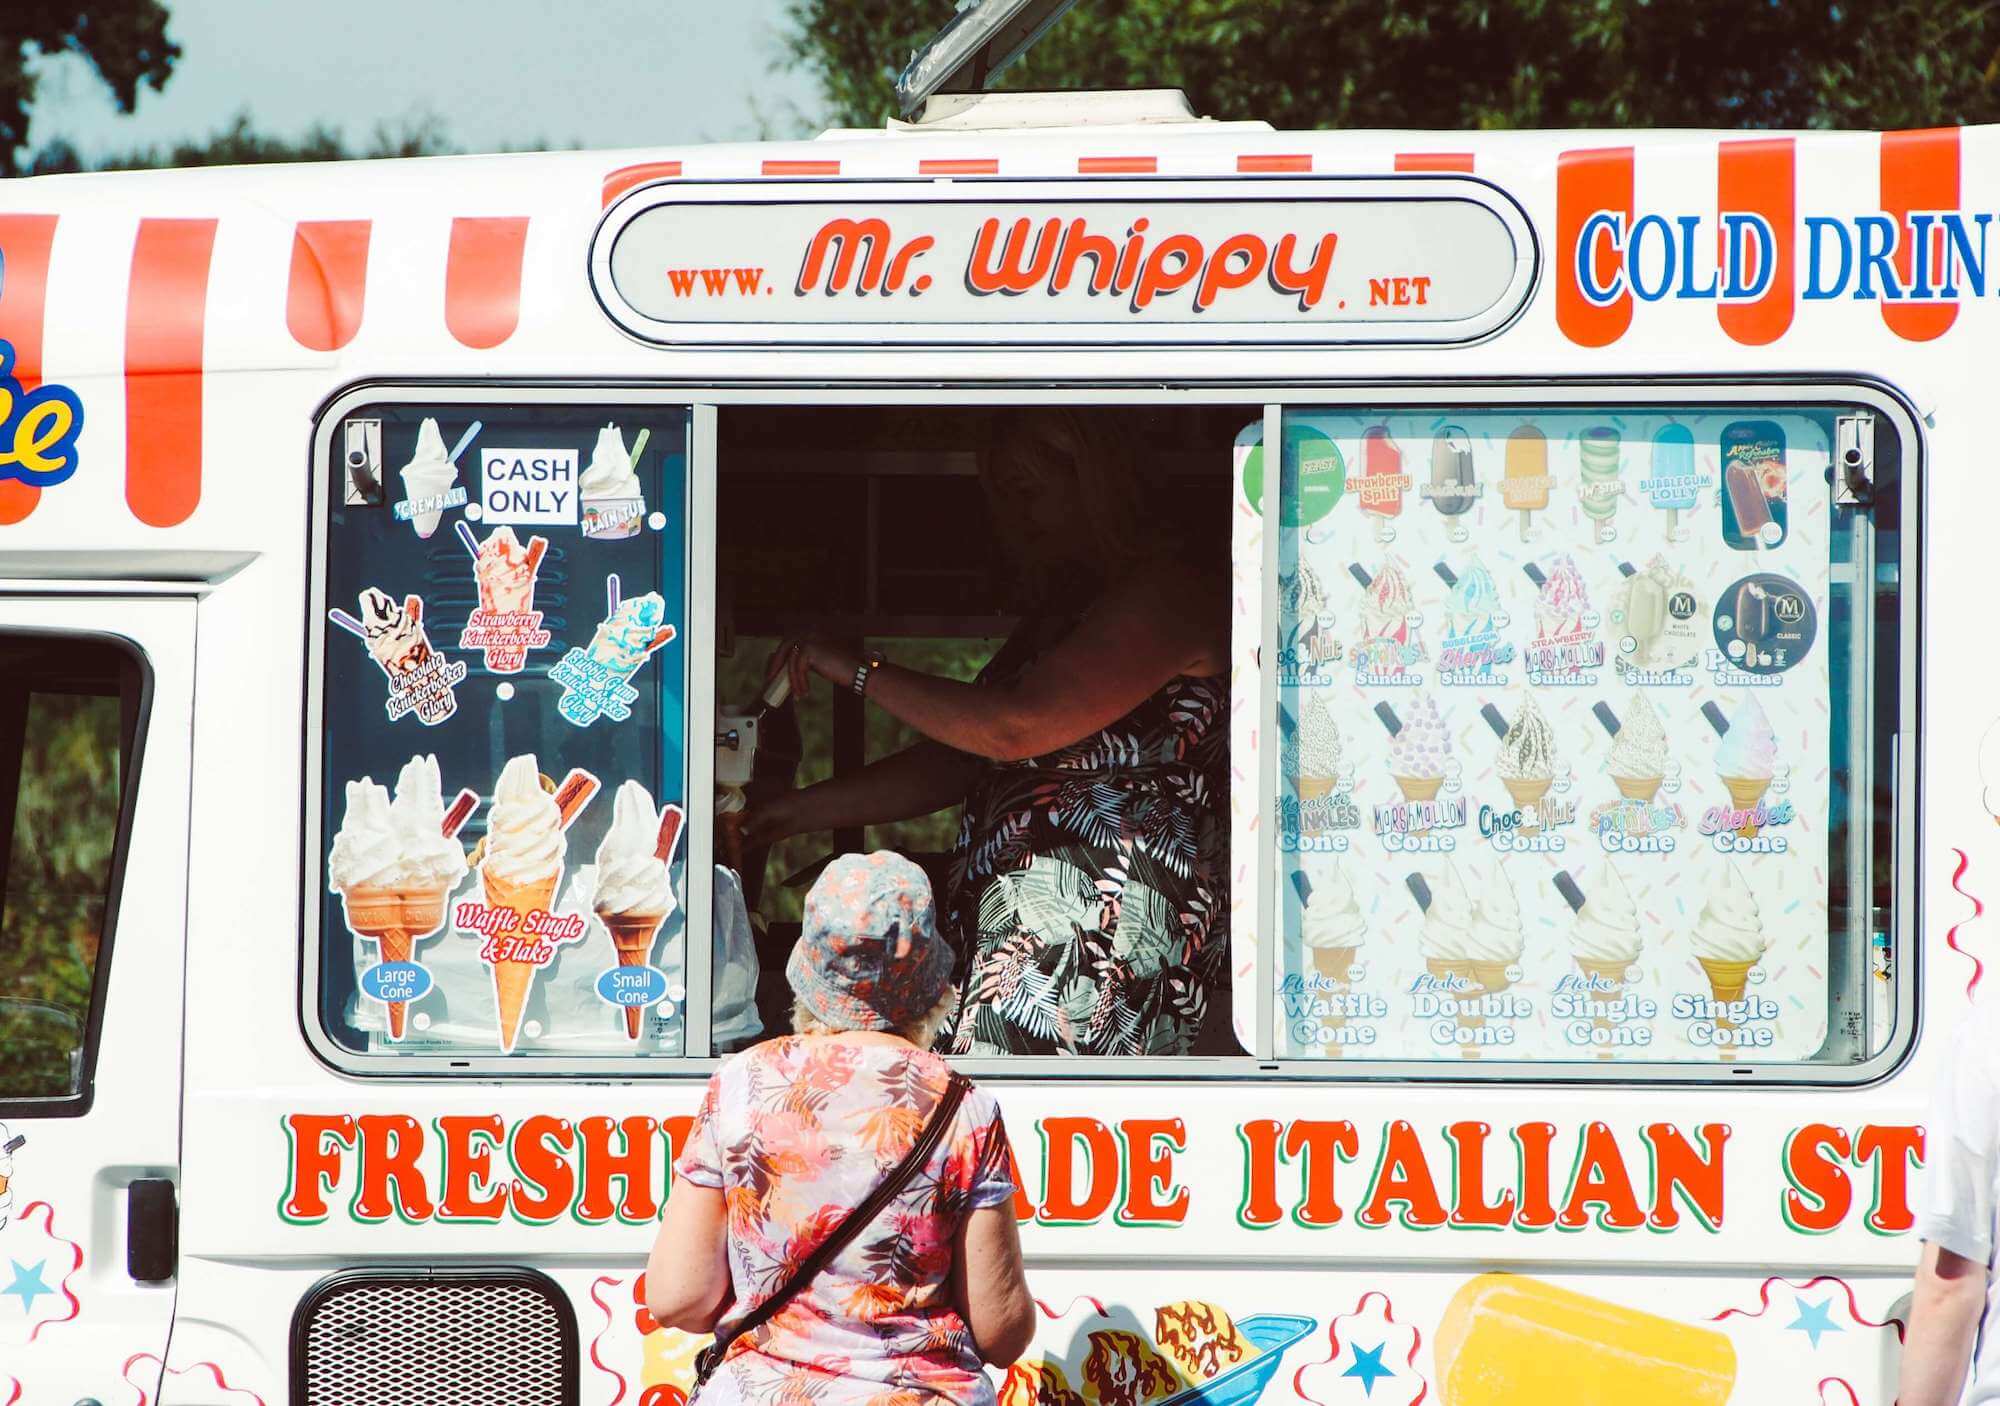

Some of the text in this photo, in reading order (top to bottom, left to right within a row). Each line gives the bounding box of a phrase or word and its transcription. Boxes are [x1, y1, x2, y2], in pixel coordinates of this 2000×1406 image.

[794, 218, 936, 298] Mr.
[1577, 213, 2000, 304] COLD DRIN
[487, 458, 571, 481] CASH
[1345, 474, 1412, 493] Strawberry
[1640, 474, 1713, 492] BUBBLEGUM
[1651, 486, 1698, 501] LOLLY
[489, 490, 569, 513] ONLY
[1361, 488, 1399, 504] Split
[581, 510, 619, 536] PLAIN
[621, 499, 646, 523] TUB
[470, 609, 539, 630] Strawberry
[462, 628, 547, 647] Knickerbocker
[1531, 632, 1593, 650] STRAWBERRY
[488, 648, 524, 669] Glory
[392, 655, 442, 694] Chocolate
[1278, 672, 1332, 688] undae
[1355, 671, 1424, 687] Sundae
[1440, 671, 1508, 687] Sundae
[1529, 671, 1598, 687] Sundae
[1624, 670, 1693, 687] Sundae
[1714, 671, 1783, 687] Sundae
[389, 663, 464, 719] Knickerbocker
[603, 675, 638, 702] Gum
[420, 694, 453, 722] Glory
[560, 694, 597, 723] Glory
[1479, 804, 1521, 839] Choc
[1539, 798, 1576, 832] Nut
[1699, 800, 1796, 836] Sherbet
[1276, 831, 1349, 853] Cone
[1382, 832, 1456, 853] Cone
[1492, 832, 1565, 853] Cone
[1601, 831, 1676, 853] Cone
[1713, 831, 1788, 853] Cone
[456, 903, 519, 931] Waffle
[523, 909, 584, 940] Single
[501, 936, 552, 963] Flake
[376, 967, 416, 986] Large
[612, 971, 652, 988] Small
[1409, 971, 1470, 993] Flake
[1552, 972, 1617, 993] Flake
[380, 984, 413, 999] Cone
[616, 988, 650, 1004] Cone
[1281, 992, 1388, 1018] Waffle
[1412, 992, 1533, 1018] Double
[1551, 992, 1657, 1023] Single
[1671, 993, 1780, 1024] Single
[1293, 1019, 1376, 1045] Cone
[1431, 1020, 1515, 1045] Cone
[1566, 1020, 1652, 1046] Cone
[1686, 1020, 1774, 1047] Cone
[277, 1113, 697, 1226] FRESH
[1236, 1118, 1732, 1236] ITALIAN
